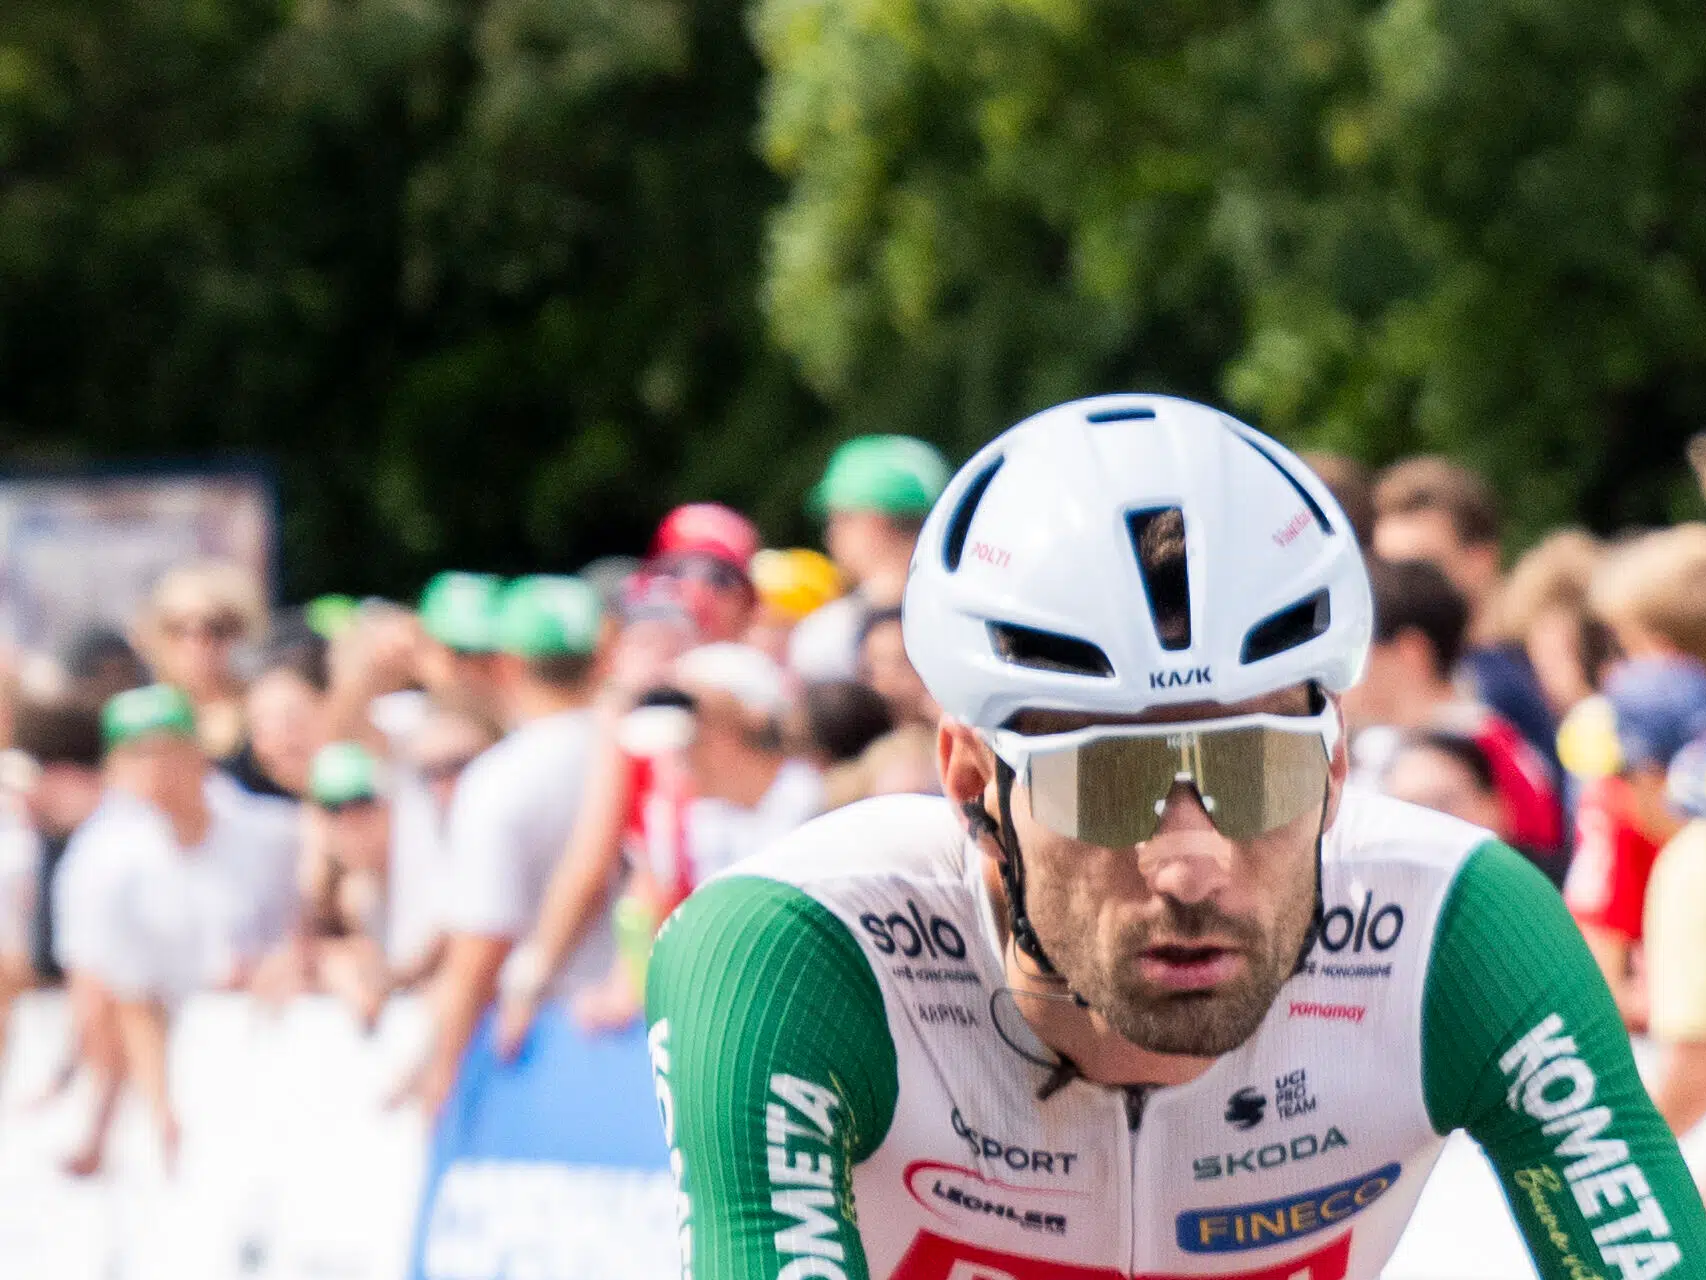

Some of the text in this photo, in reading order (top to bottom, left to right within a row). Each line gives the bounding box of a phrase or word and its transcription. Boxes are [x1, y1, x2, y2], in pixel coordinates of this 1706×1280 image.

[1149, 666, 1214, 690] KASK
[859, 899, 968, 961] solo
[1319, 889, 1404, 952] olo
[1288, 1000, 1367, 1025] yamamay
[1275, 1068, 1306, 1089] UCI
[1200, 1176, 1389, 1246] FINECO
